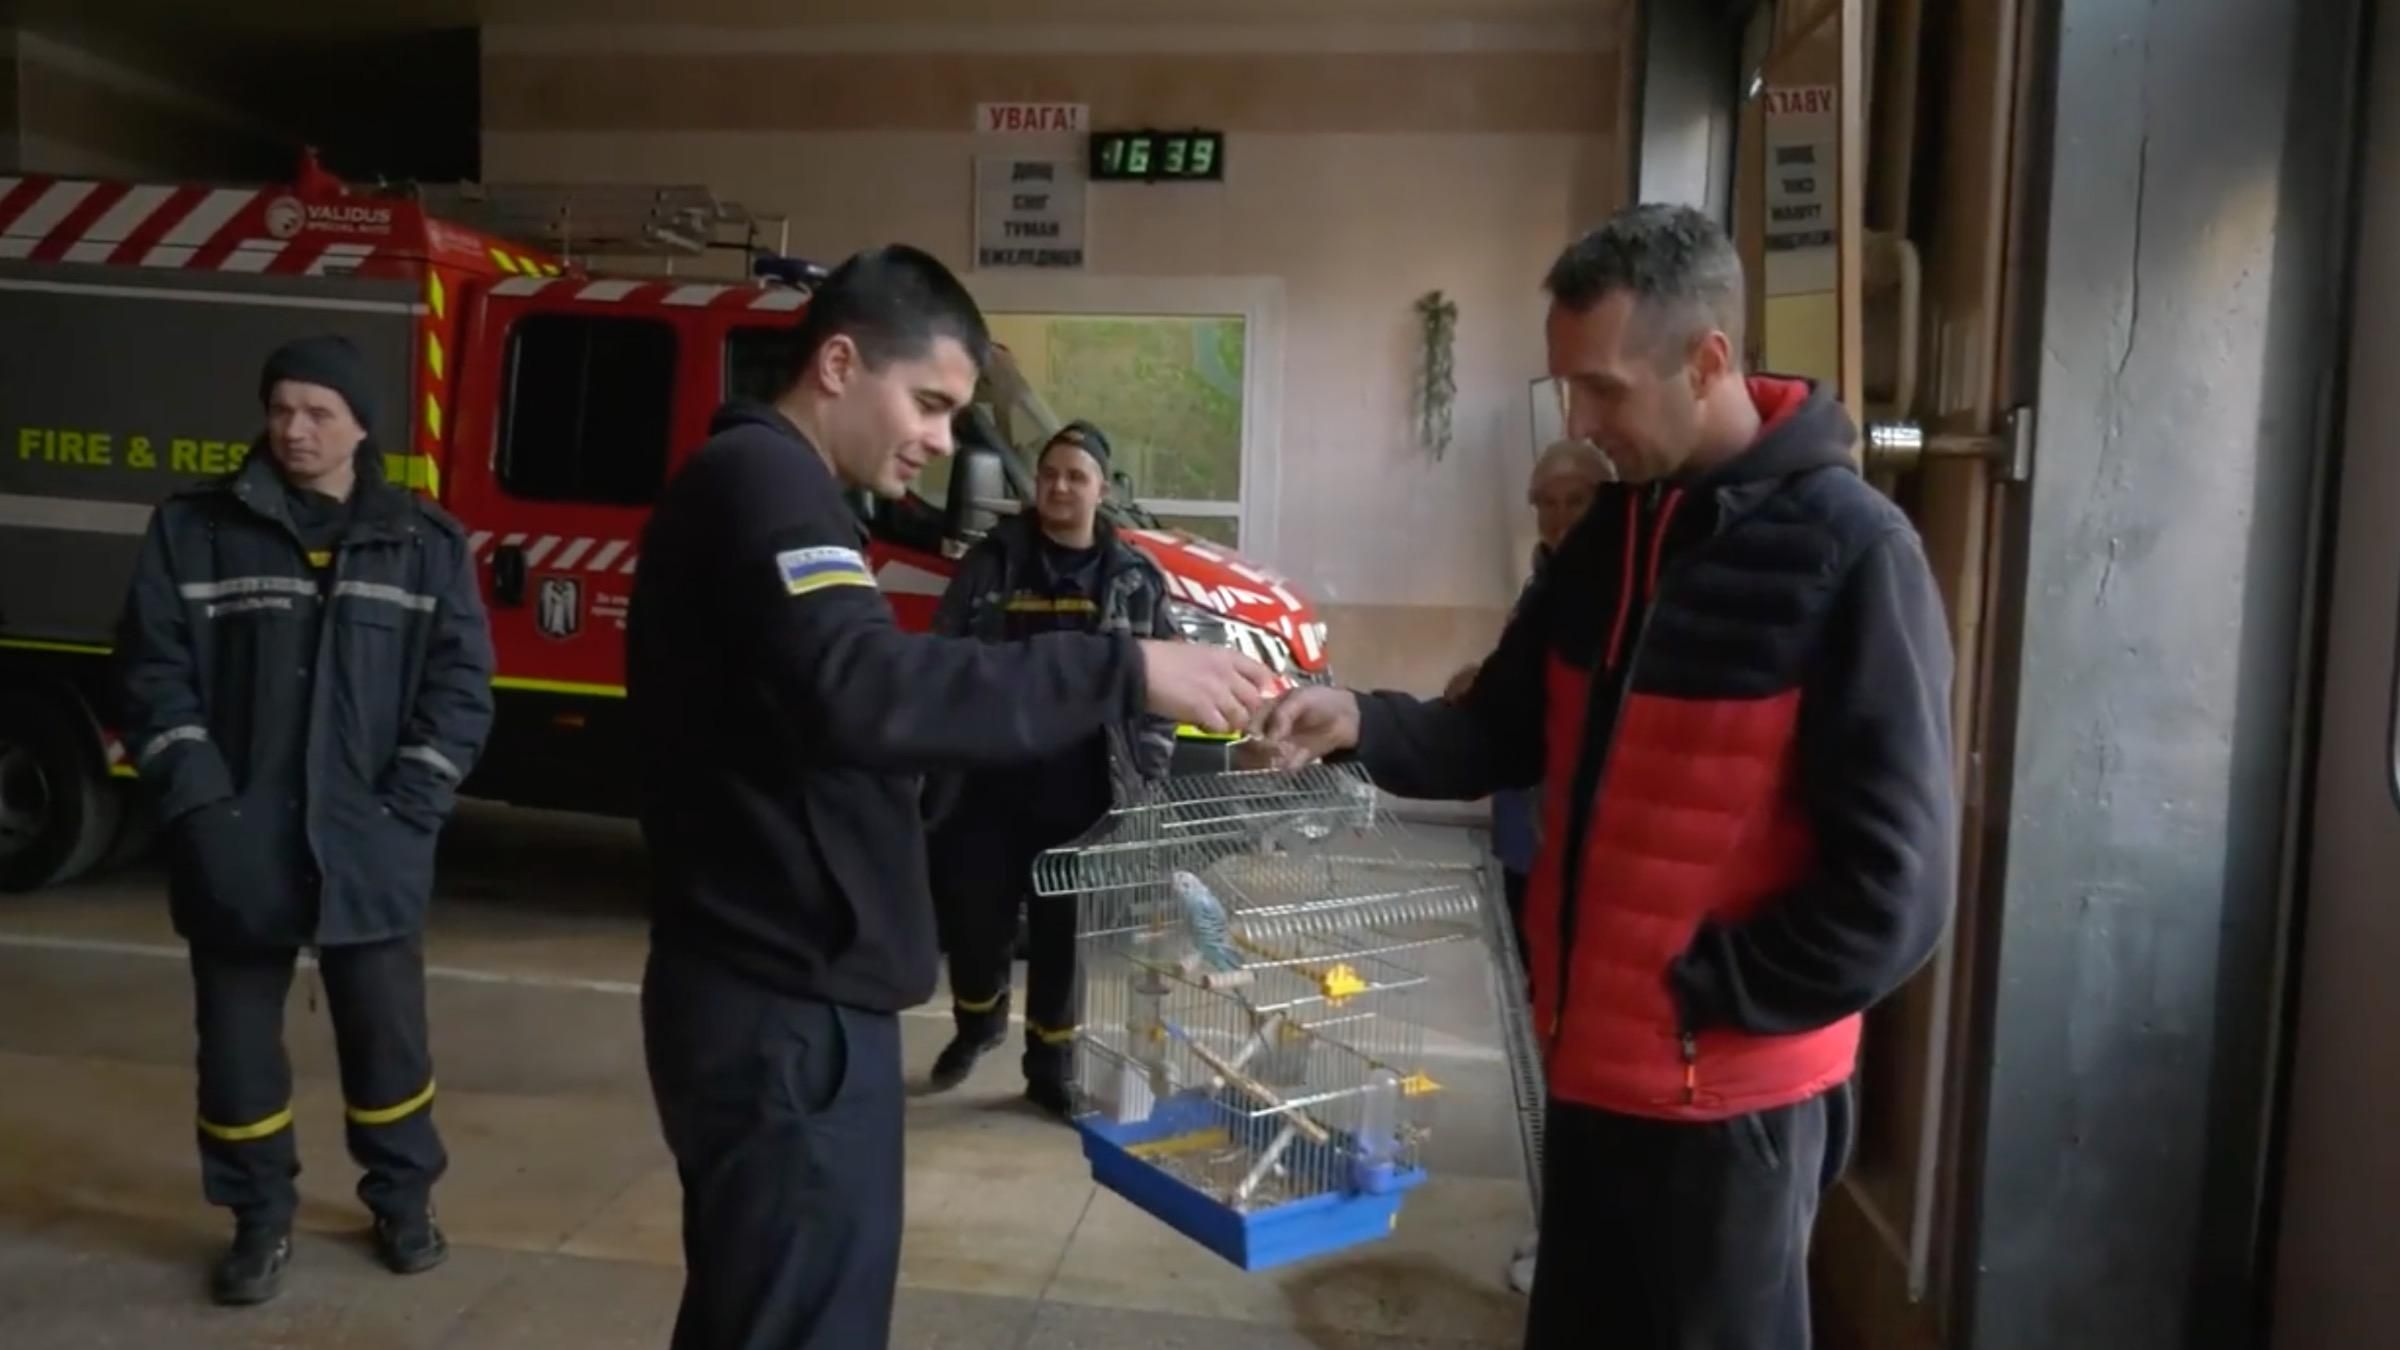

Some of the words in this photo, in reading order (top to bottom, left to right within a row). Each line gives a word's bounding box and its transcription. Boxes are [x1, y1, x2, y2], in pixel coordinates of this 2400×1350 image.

[990, 106, 1078, 131] УВАГА!
[306, 205, 391, 224] VALIDUS
[18, 428, 112, 466] FIRE
[127, 436, 156, 469] &
